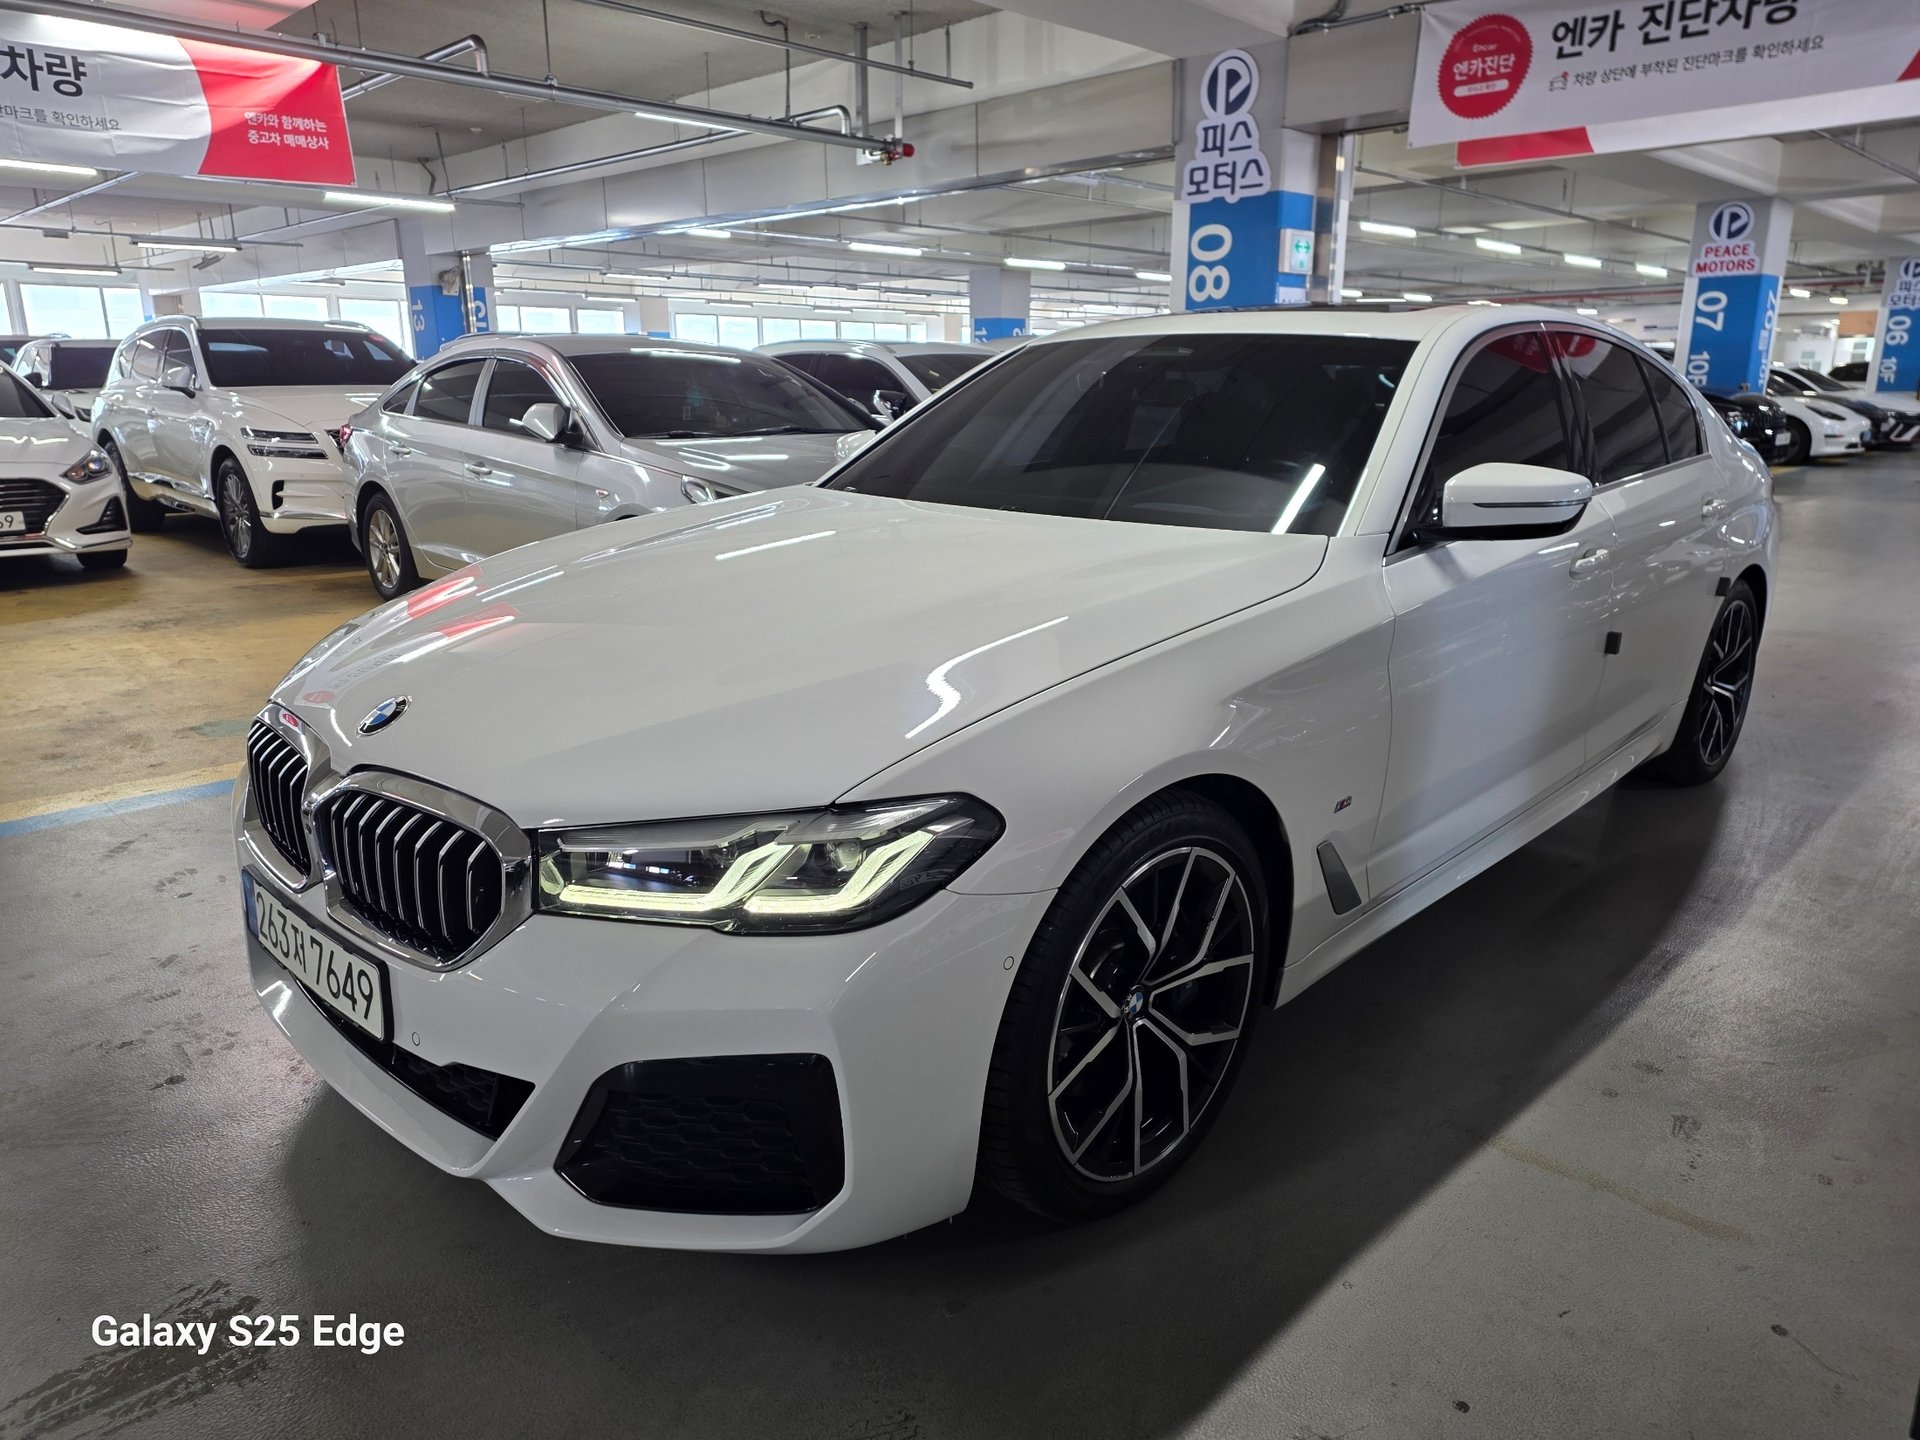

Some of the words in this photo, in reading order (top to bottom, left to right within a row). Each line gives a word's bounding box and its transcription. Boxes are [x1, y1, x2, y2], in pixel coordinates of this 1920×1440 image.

[1551, 8, 1625, 60] 엔카
[1453, 53, 1516, 80] 엔카진단
[1683, 46, 1748, 71] 진단마크를
[1752, 34, 1824, 60] 확인하세요
[0, 45, 88, 97] 차량
[51, 110, 122, 130] 확인하세요
[244, 112, 280, 129] 엔카와
[281, 115, 327, 133] 함께하는
[247, 129, 281, 146] 중고차
[283, 134, 330, 150] 매매상사
[1201, 120, 1253, 158] 피스
[1187, 158, 1264, 196] 모터스
[1188, 223, 1233, 302] 08
[1695, 258, 1756, 273] MOTORS
[1704, 243, 1750, 258] PEACE
[412, 299, 426, 332] 13
[1695, 290, 1728, 332] 07
[1886, 315, 1912, 346] 06
[1687, 350, 1711, 387] 10F
[1880, 356, 1897, 384] 10F
[310, 934, 374, 1020] 7649
